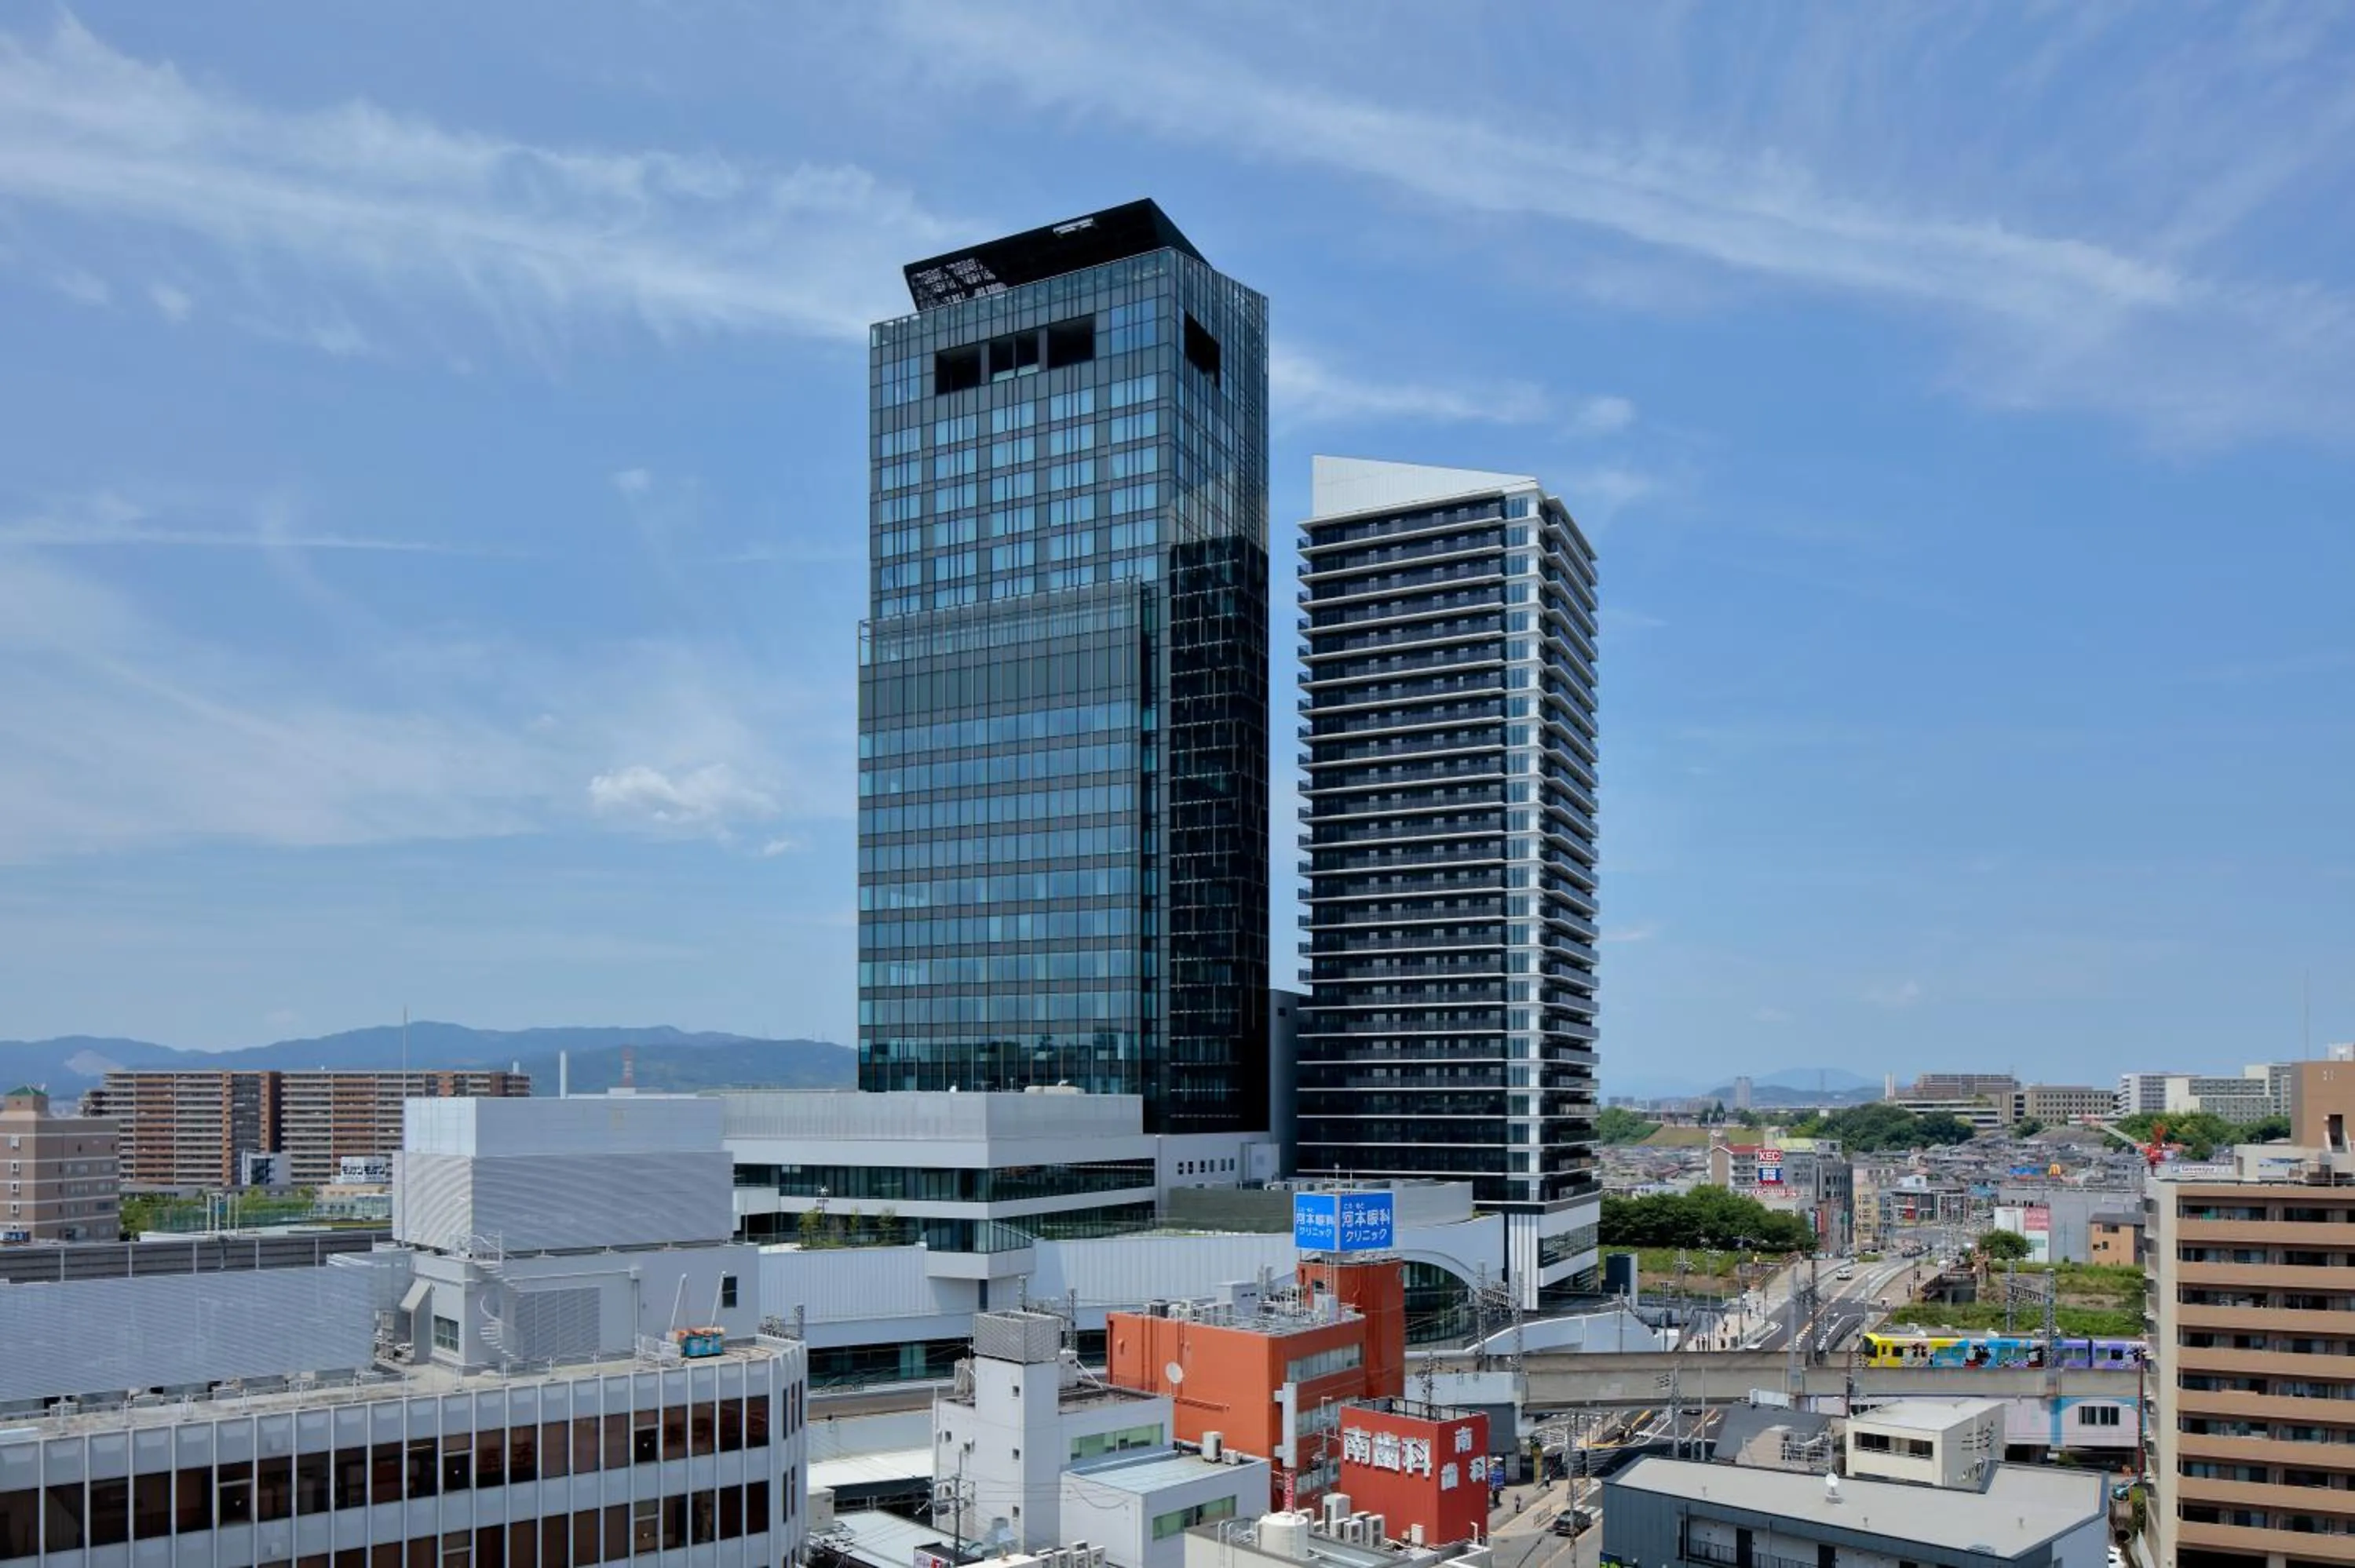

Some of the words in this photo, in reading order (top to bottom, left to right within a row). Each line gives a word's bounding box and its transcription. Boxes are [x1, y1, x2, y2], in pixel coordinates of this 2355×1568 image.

[1759, 1151, 1781, 1161] KEC
[1342, 1208, 1390, 1227] 河本眼科
[1299, 1226, 1332, 1238] クリニック
[1345, 1228, 1388, 1242] クリニック
[1343, 1425, 1433, 1478] 南歯科
